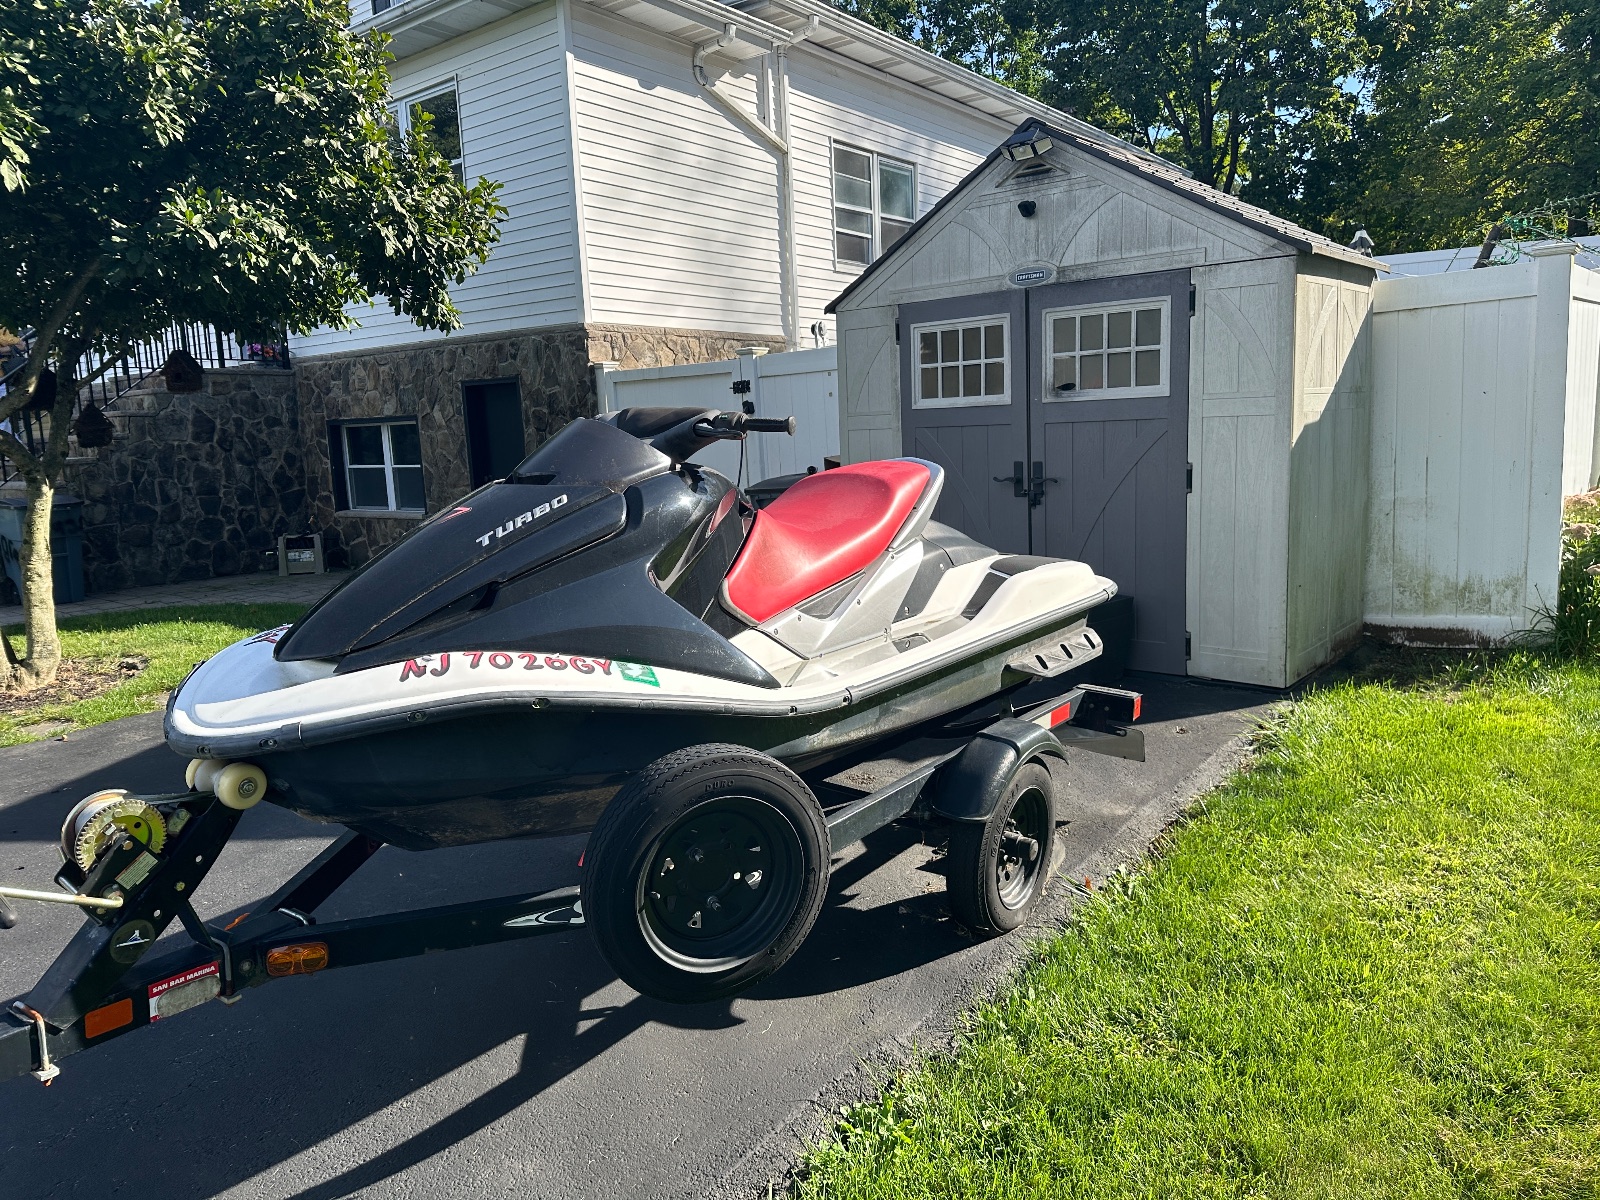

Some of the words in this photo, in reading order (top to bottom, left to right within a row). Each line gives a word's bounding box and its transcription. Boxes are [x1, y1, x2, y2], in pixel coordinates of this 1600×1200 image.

[475, 493, 568, 547] TURBO
[399, 652, 451, 683] NJ
[462, 650, 613, 676] 7026GY
[704, 779, 735, 792] DURO
[152, 983, 168, 993] SAN
[169, 976, 185, 987] BAR
[186, 965, 215, 980] MARINA
